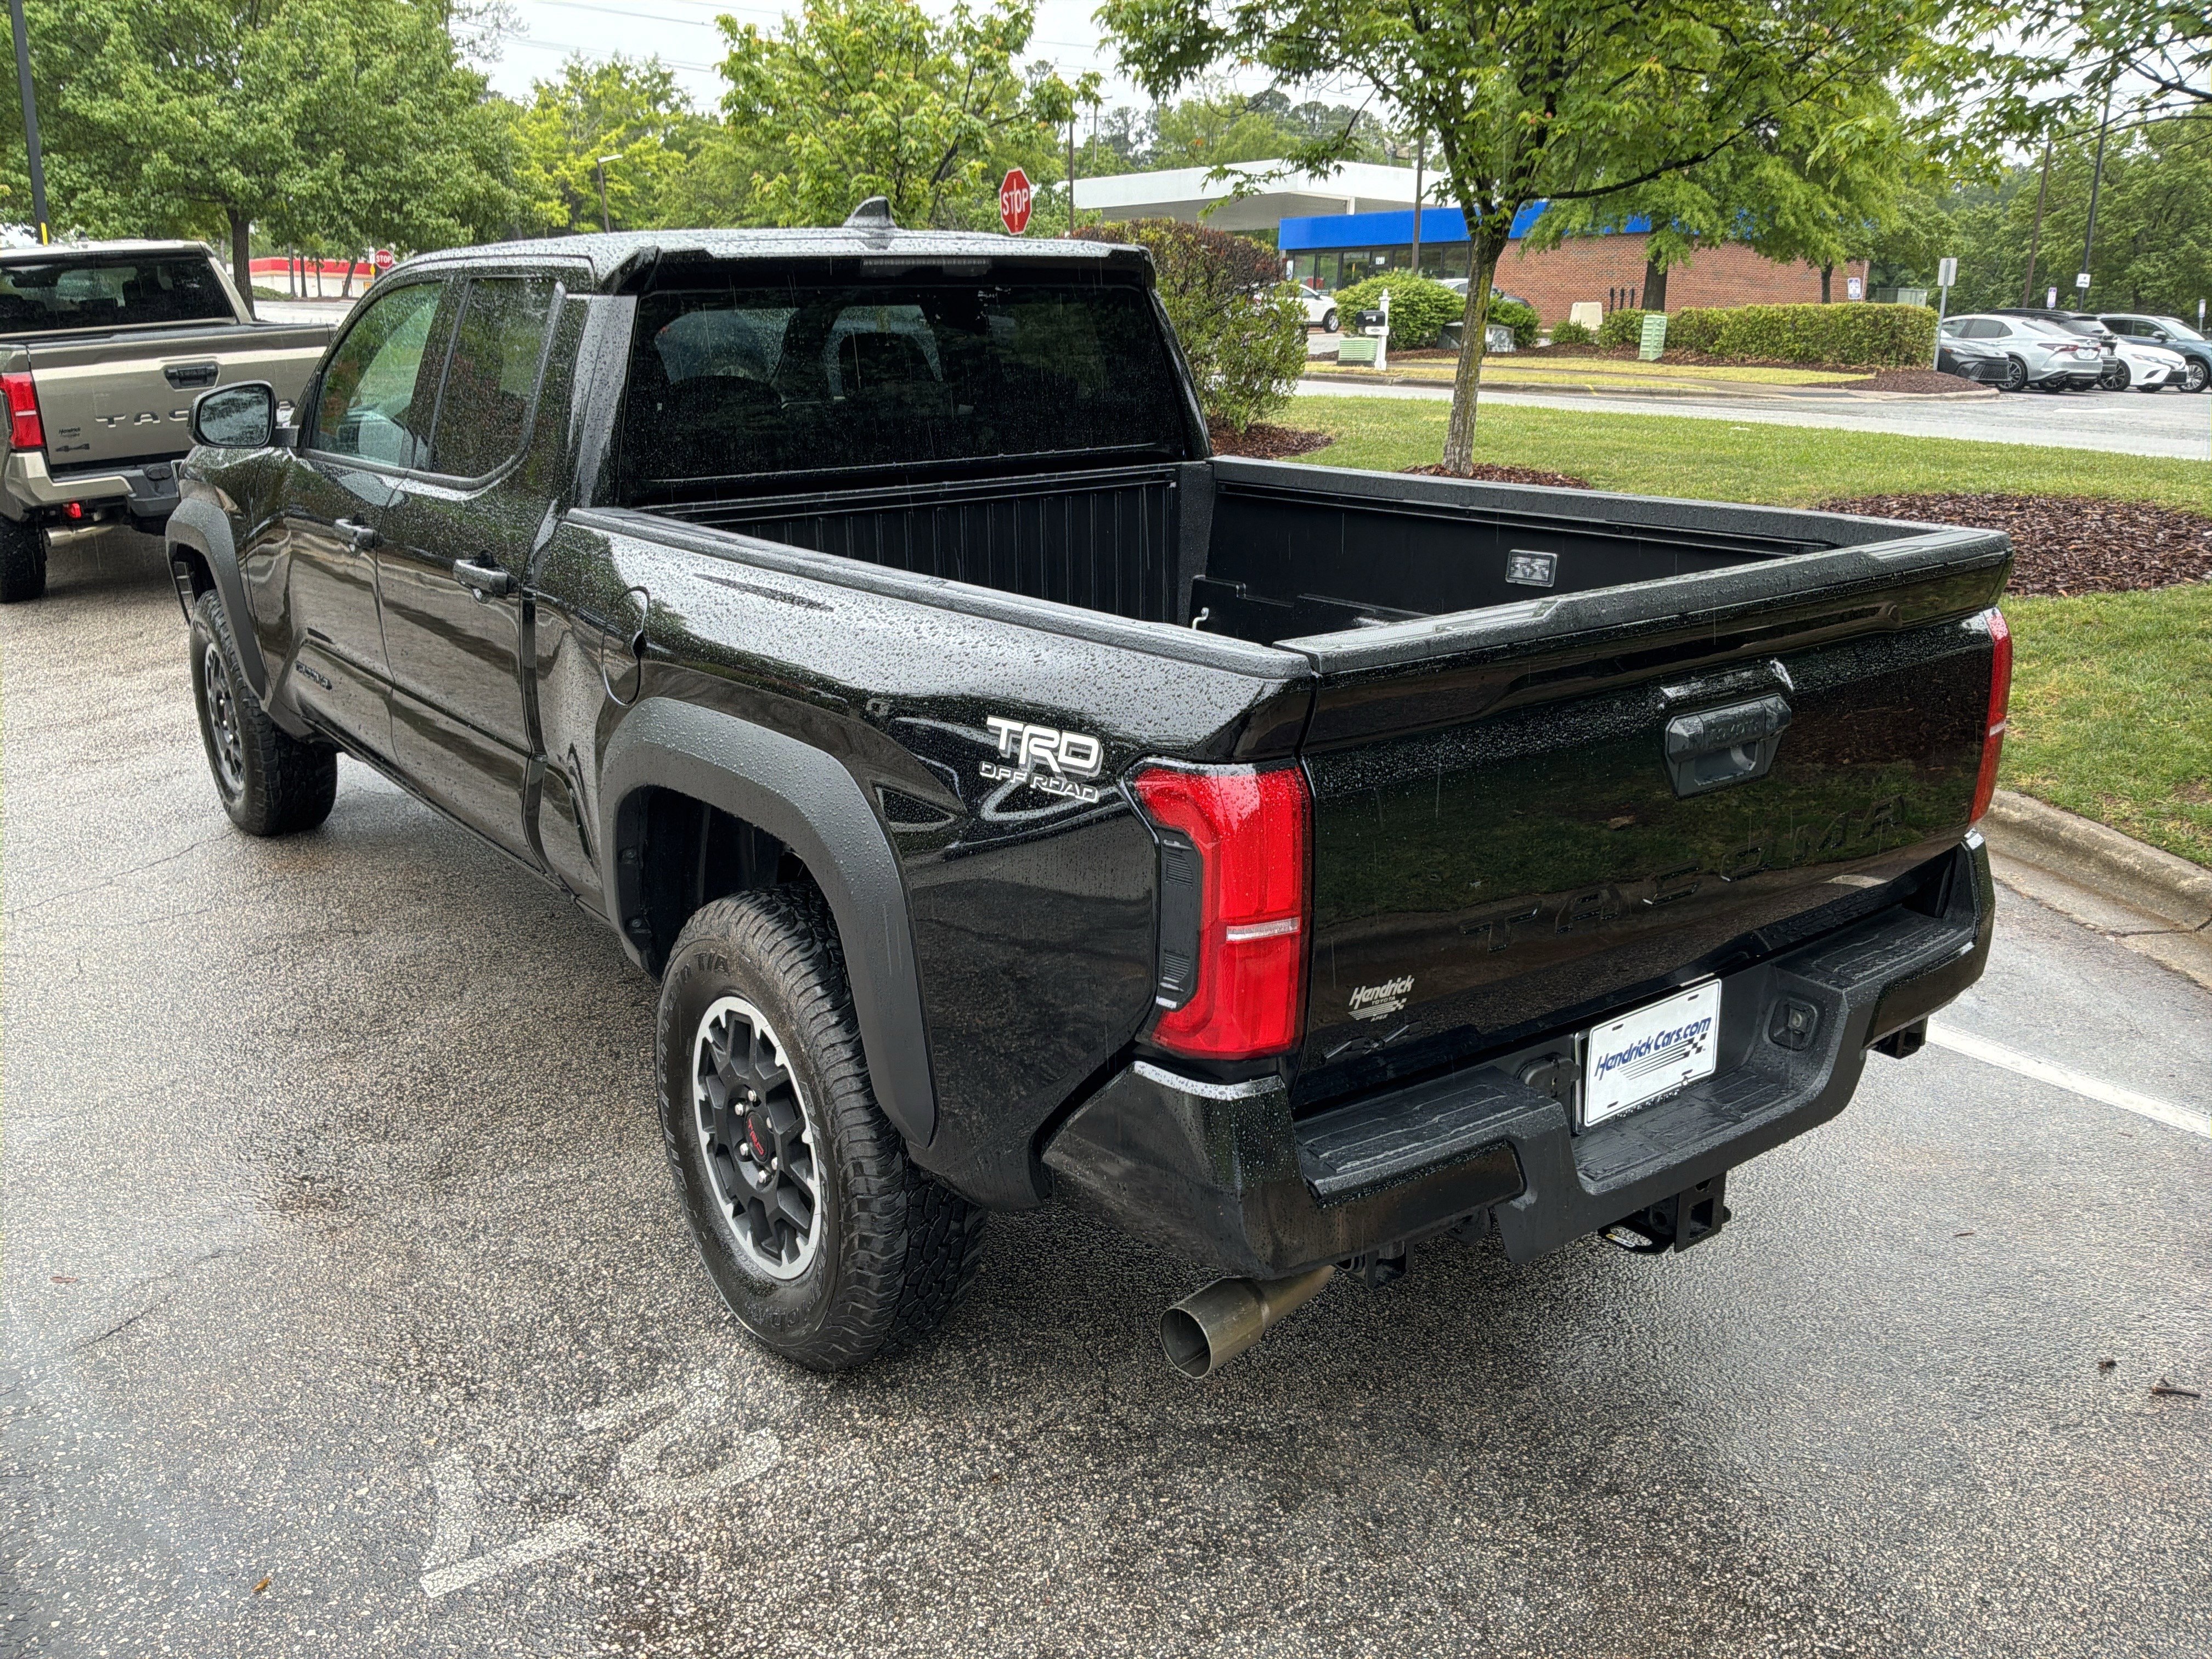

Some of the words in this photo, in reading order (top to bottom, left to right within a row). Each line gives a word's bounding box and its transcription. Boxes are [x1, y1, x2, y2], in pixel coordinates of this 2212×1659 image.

[1003, 188, 1029, 216] STOP
[376, 255, 392, 263] STOP
[986, 716, 1102, 776] TRD
[979, 761, 1027, 783] OFF
[1030, 773, 1099, 803] ROAD
[1459, 794, 1906, 953] TACOMA
[1348, 974, 1415, 1010] Hendrick
[1372, 996, 1396, 1006] TOYOTA
